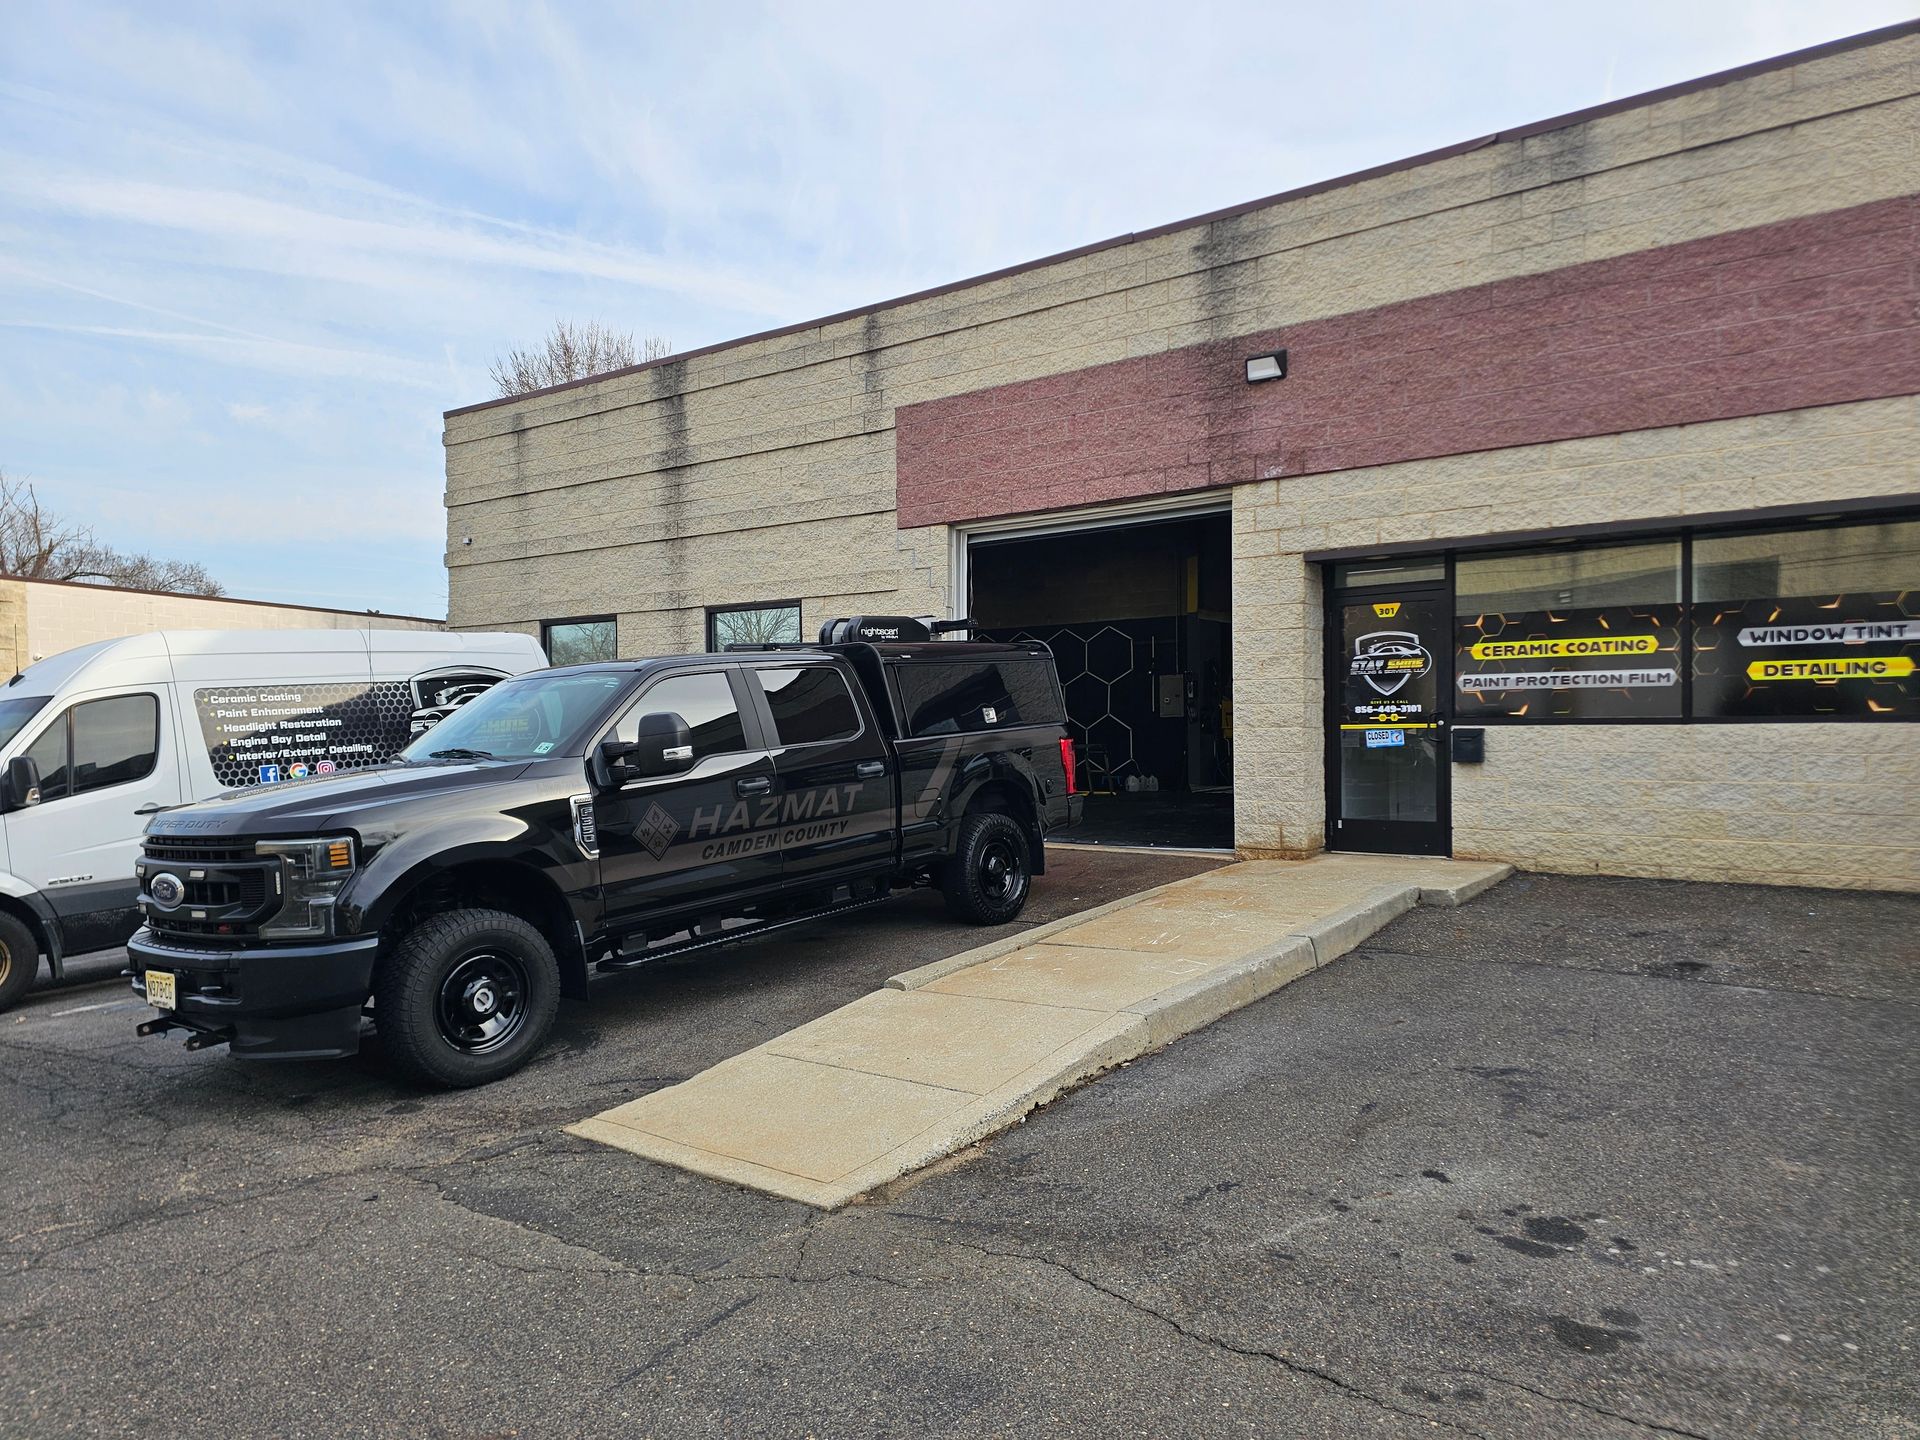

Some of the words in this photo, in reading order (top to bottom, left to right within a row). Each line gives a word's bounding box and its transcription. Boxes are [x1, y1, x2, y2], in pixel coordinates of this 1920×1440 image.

[1378, 607, 1395, 616] 301
[860, 627, 898, 637] nightscan
[1750, 627, 1846, 643] WINDOW
[1853, 624, 1908, 639] TINT
[1481, 643, 1560, 657] CERAMIC
[1566, 639, 1649, 654] COATING
[1350, 660, 1385, 670] STAY
[1763, 661, 1887, 677] DETAILING
[1463, 677, 1511, 688] PAINT
[1515, 673, 1623, 687] PROTECTION
[1629, 672, 1671, 683] FILM
[210, 693, 257, 704] Ceramic
[260, 693, 301, 702] Coating
[217, 708, 248, 718] Paint
[250, 706, 324, 717] Enhancement
[1354, 704, 1422, 714] 856-449-3101
[223, 722, 277, 733] Headlight
[279, 718, 342, 730] Restoration
[230, 737, 268, 748] Engine
[270, 735, 293, 745] Bay
[295, 732, 327, 743] Detail
[1367, 731, 1390, 741] CLOSED
[235, 747, 327, 761] Interior/Exterior
[328, 744, 374, 754] Detailing
[688, 784, 864, 839] HAZMAT
[185, 820, 229, 829] DUTY
[702, 834, 778, 860] CAMDEN
[784, 820, 849, 845] COUNTY
